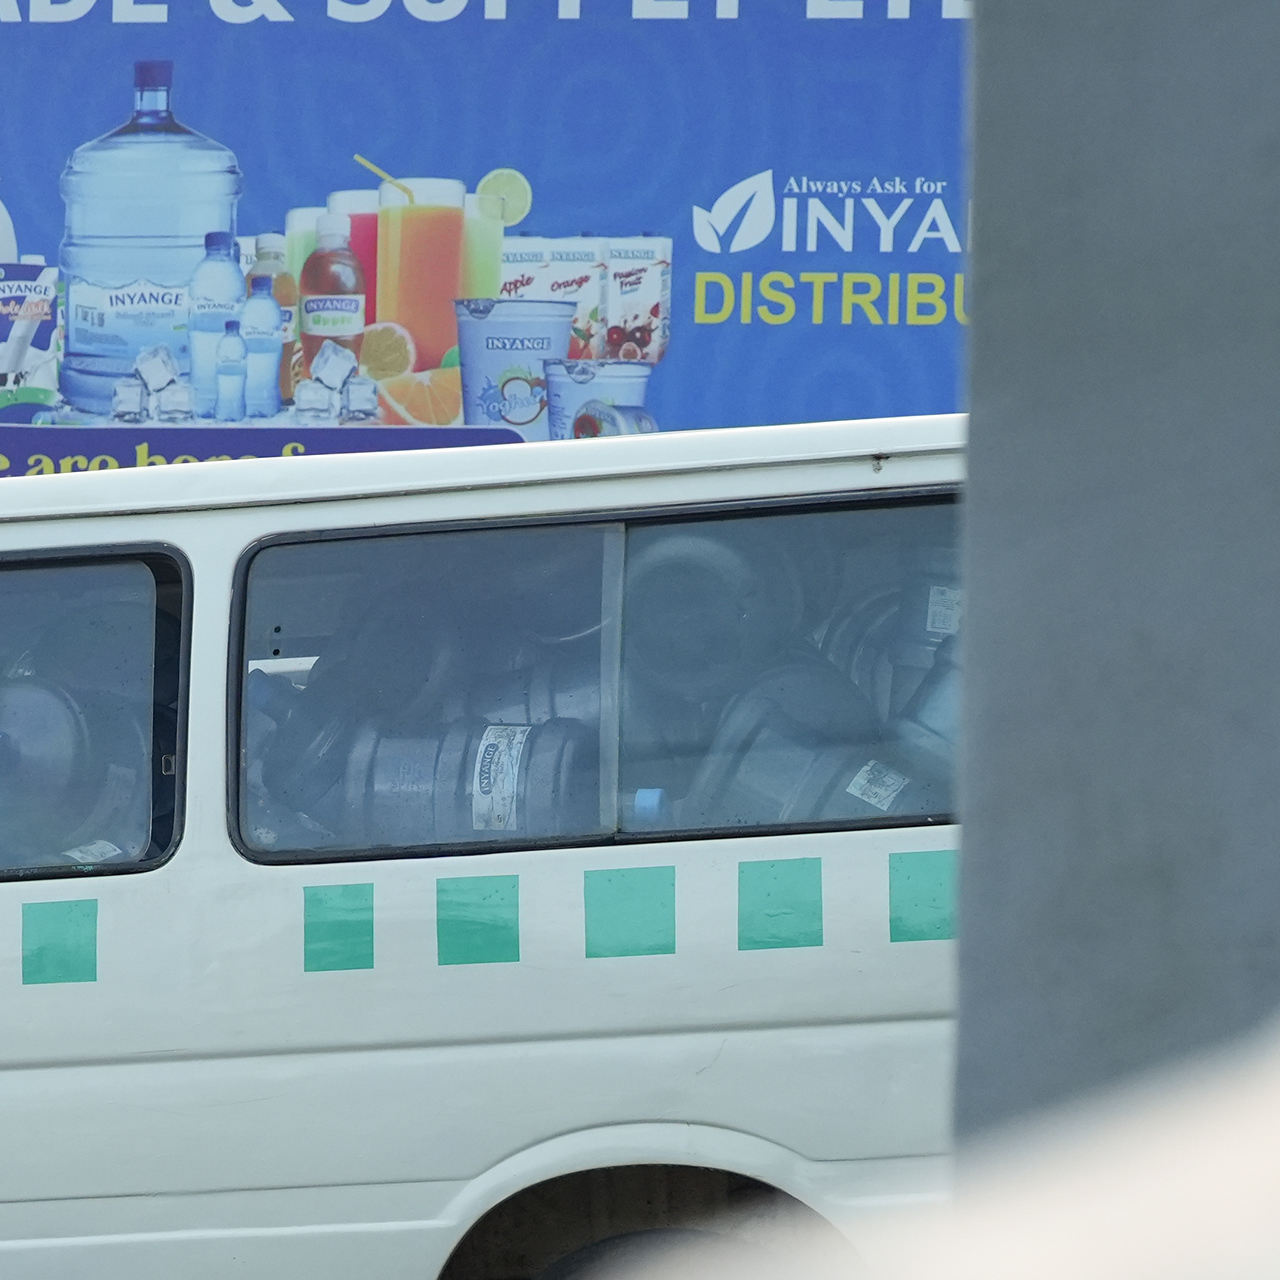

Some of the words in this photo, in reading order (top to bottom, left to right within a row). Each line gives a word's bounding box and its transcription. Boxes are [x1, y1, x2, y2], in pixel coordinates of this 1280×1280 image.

[783, 177, 862, 198] Always
[866, 176, 908, 195] Ask
[914, 176, 947, 194] for
[499, 273, 535, 297] Apple
[550, 275, 591, 293] Orange
[109, 291, 184, 307] INYANGE
[306, 300, 358, 312] INYANGE
[486, 336, 552, 351] INYANGE
[480, 744, 497, 792] INYANGE
